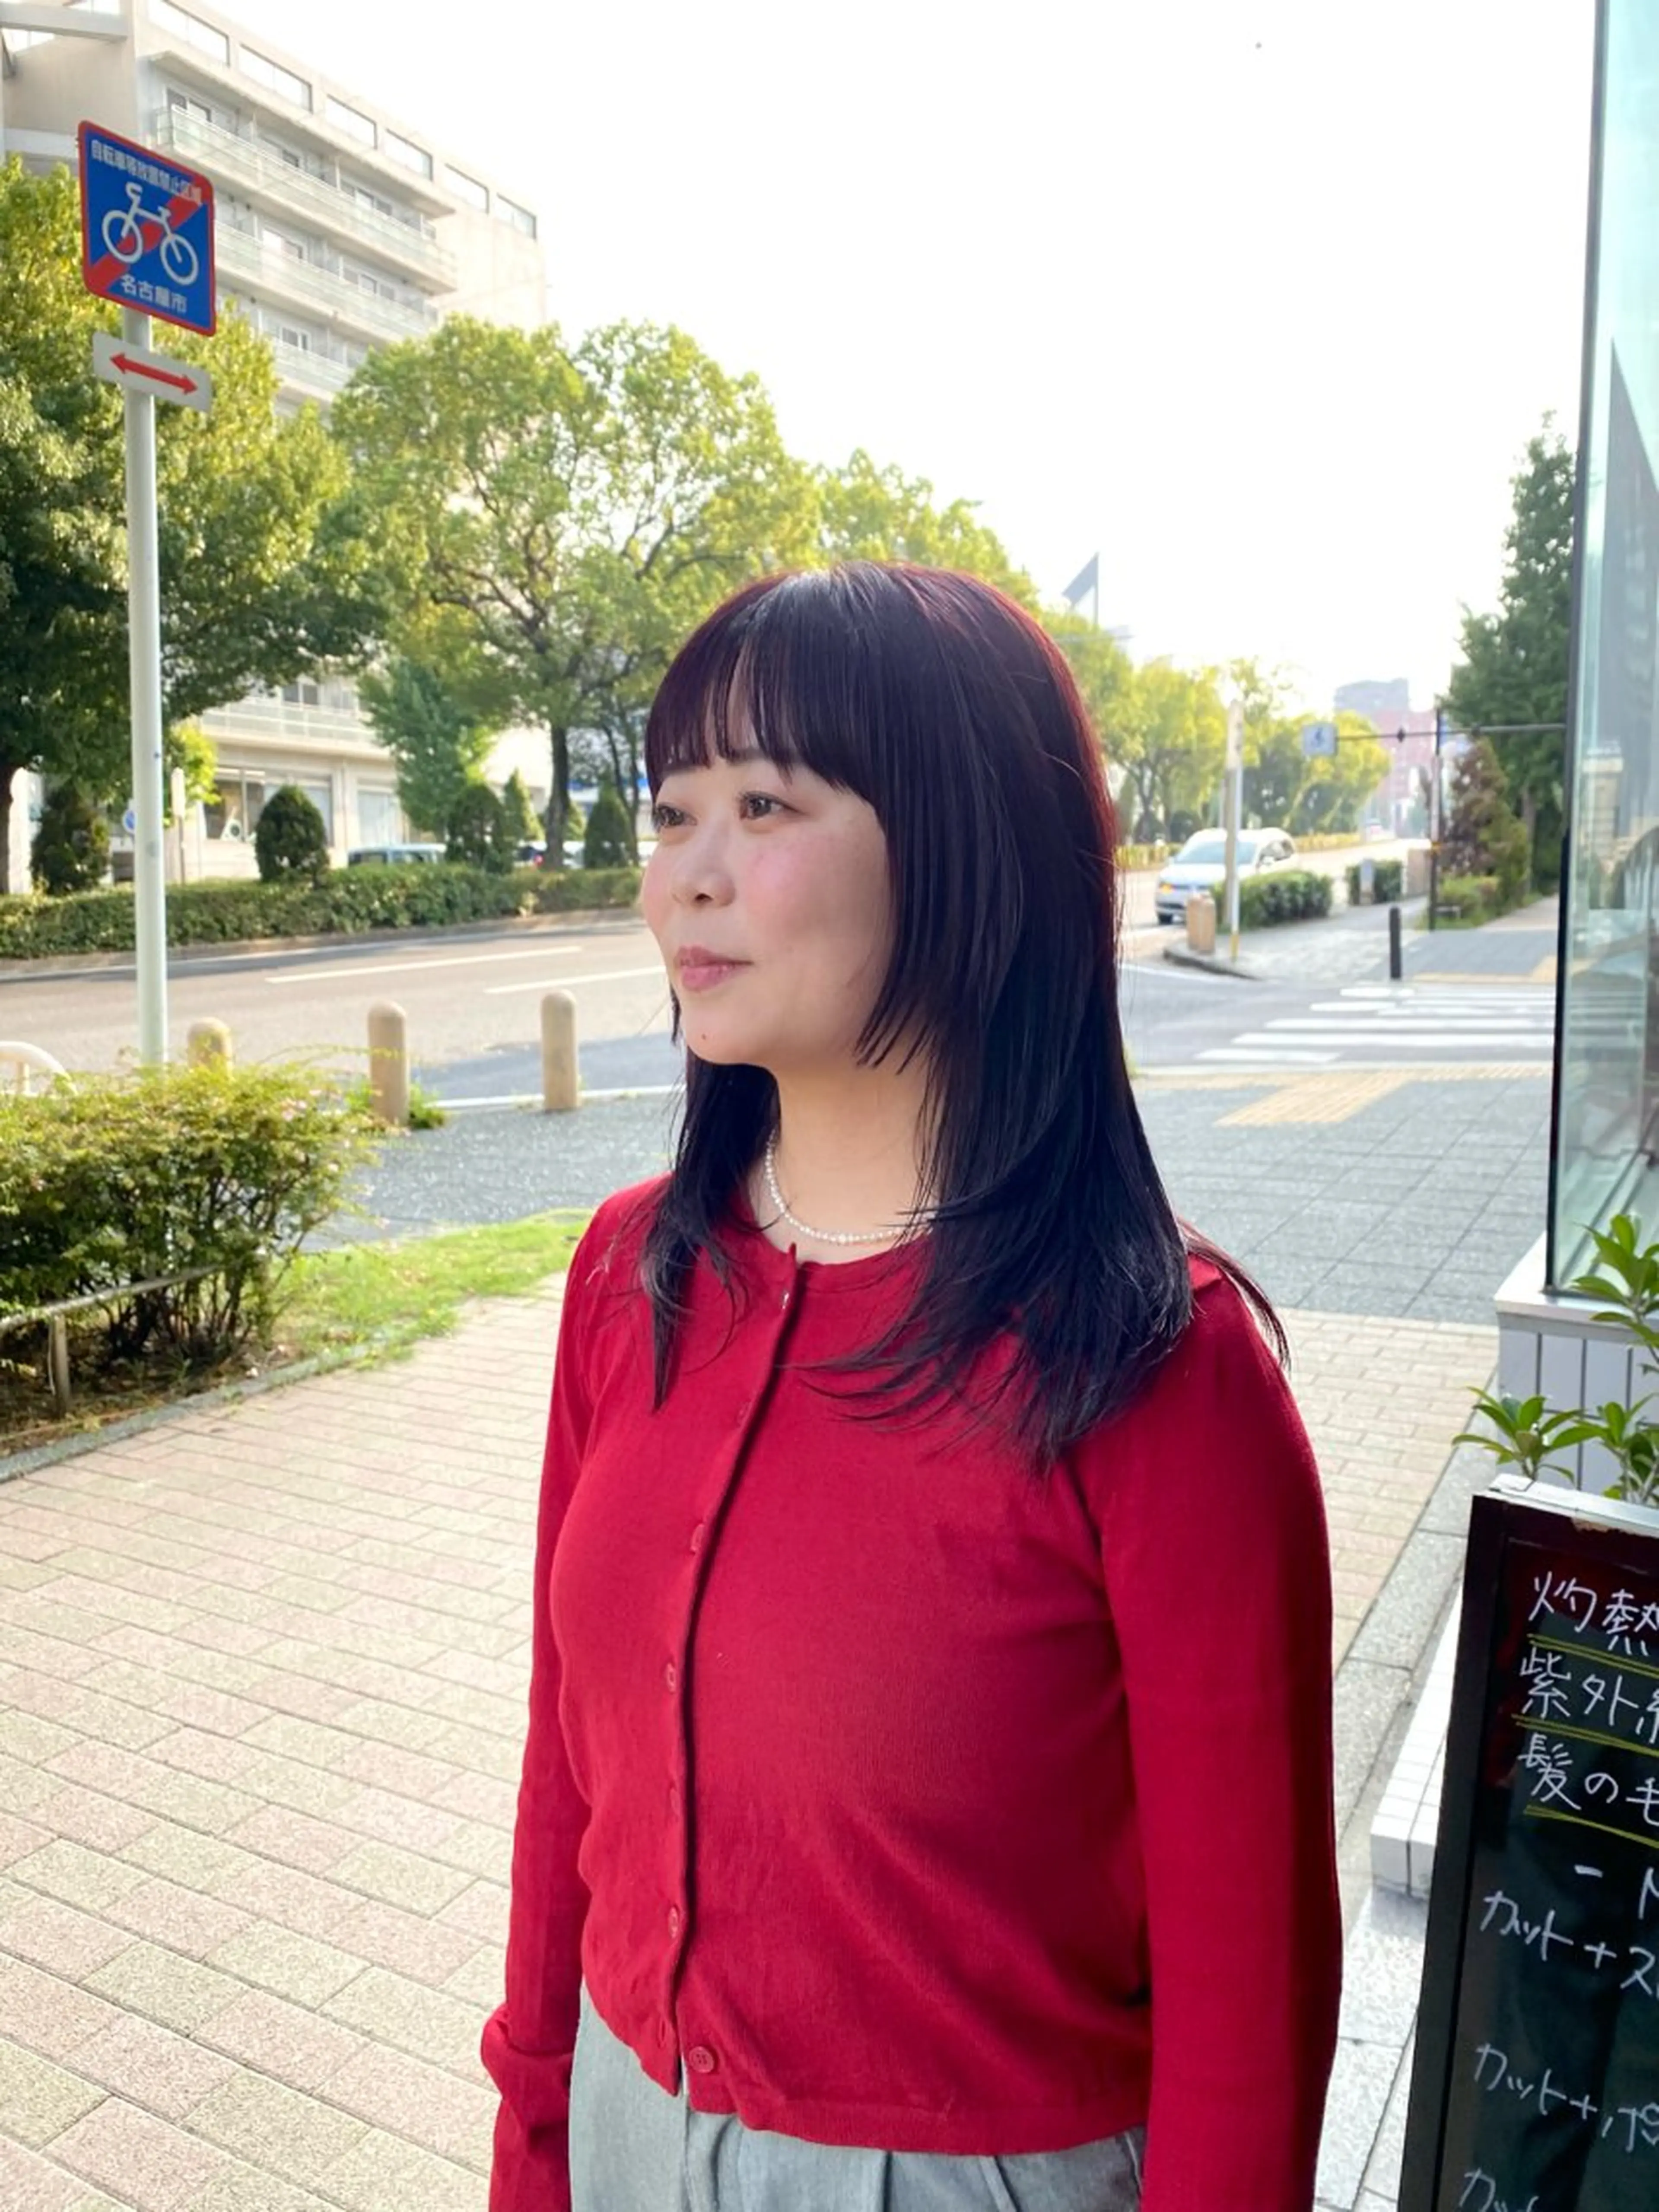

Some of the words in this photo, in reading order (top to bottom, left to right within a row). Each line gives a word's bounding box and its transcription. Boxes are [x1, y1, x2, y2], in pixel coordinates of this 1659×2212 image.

[120, 273, 187, 314] 名古屋市
[1529, 1571, 1659, 1656] 灼熱
